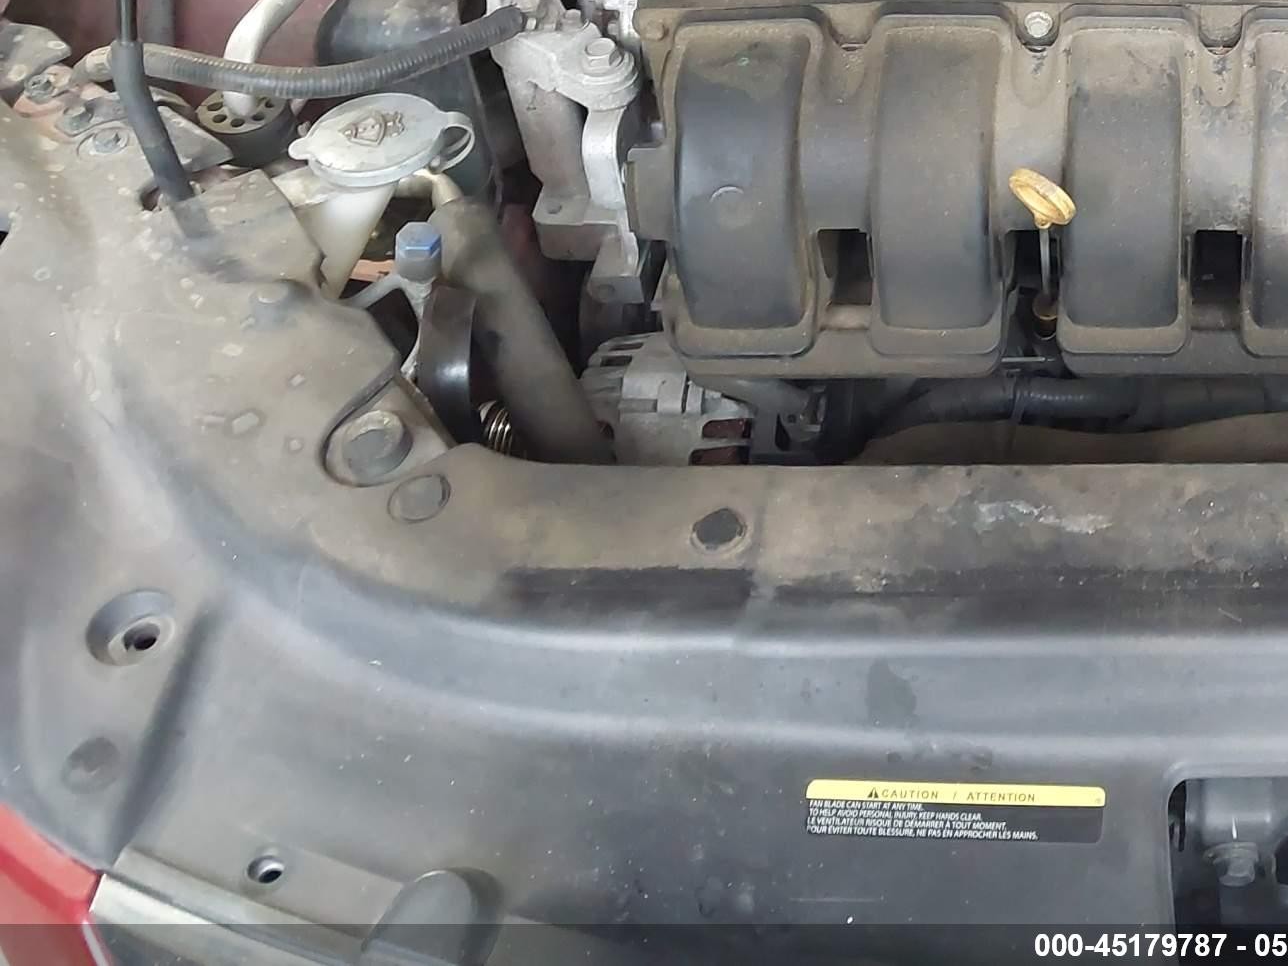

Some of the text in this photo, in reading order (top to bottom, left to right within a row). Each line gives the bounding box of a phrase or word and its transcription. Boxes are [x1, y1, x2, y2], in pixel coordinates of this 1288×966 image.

[881, 789, 938, 799] CAUTION
[966, 792, 1035, 802] ATTENTION
[809, 800, 823, 808] FAN
[823, 801, 845, 809] BLADE
[846, 801, 861, 809] CAN
[862, 802, 881, 810] START
[882, 802, 891, 810] AT
[892, 802, 906, 810] ANY
[809, 808, 819, 816] TO
[820, 809, 836, 817] HELP
[837, 809, 858, 817] AVOID
[860, 810, 893, 818] PERSONAL
[918, 811, 935, 819] KEEP
[936, 812, 960, 820] HANDS
[807, 816, 816, 824] LE
[816, 816, 864, 826] VENTILATEUR
[865, 818, 891, 827] RISQUE
[893, 819, 903, 827] DE
[952, 820, 972, 829] TOUT
[807, 825, 827, 834] POUR
[853, 826, 877, 835] TOUTE
[916, 828, 927, 836] NE
[928, 828, 941, 837] PAS
[954, 829, 998, 838] APPROCHER
[998, 830, 1011, 839] LES
